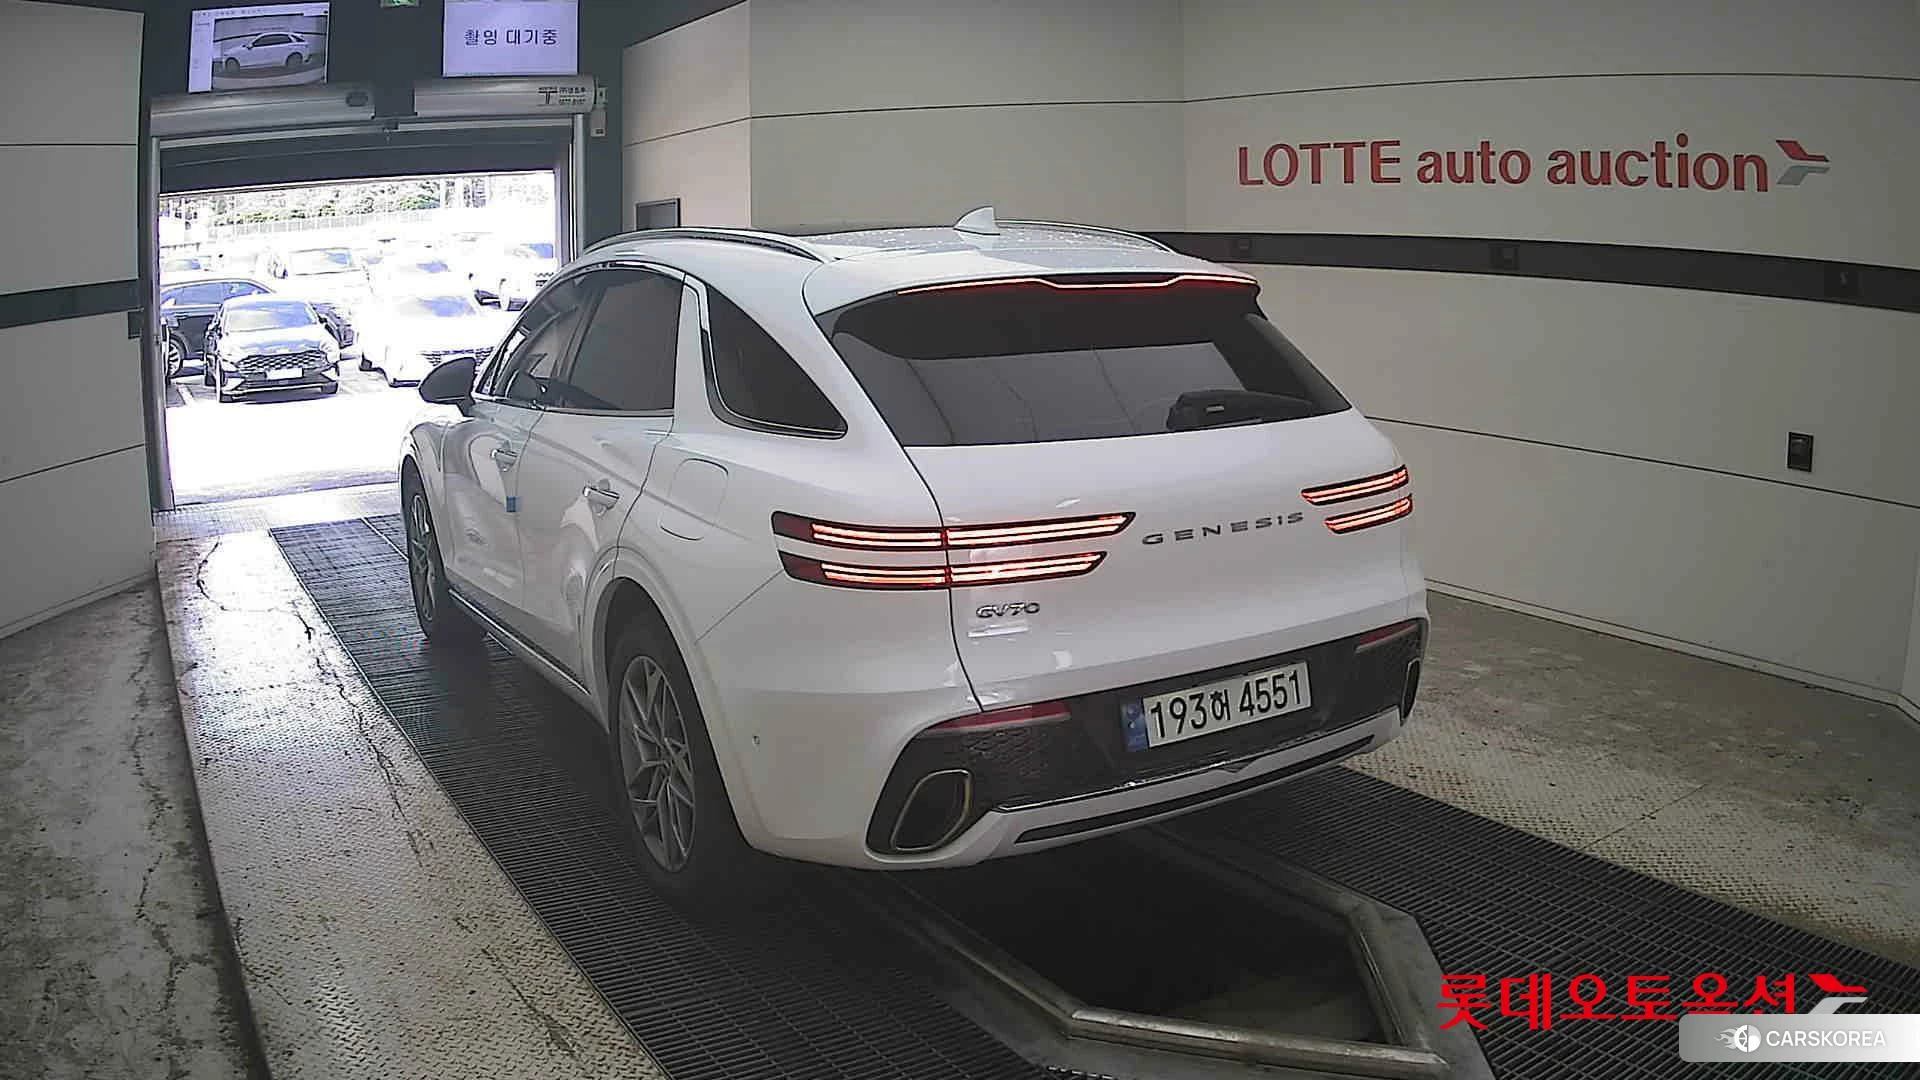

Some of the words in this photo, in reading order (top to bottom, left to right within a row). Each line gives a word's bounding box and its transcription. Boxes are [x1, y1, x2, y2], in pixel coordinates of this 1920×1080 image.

[505, 28, 559, 46] 대기중
[1238, 140, 1402, 187] LOTTE
[1416, 141, 1532, 185] auto
[1547, 133, 1769, 193] auction
[1141, 511, 1304, 545] GENESIS
[975, 602, 1041, 618] GV70
[1238, 669, 1302, 718] 4551
